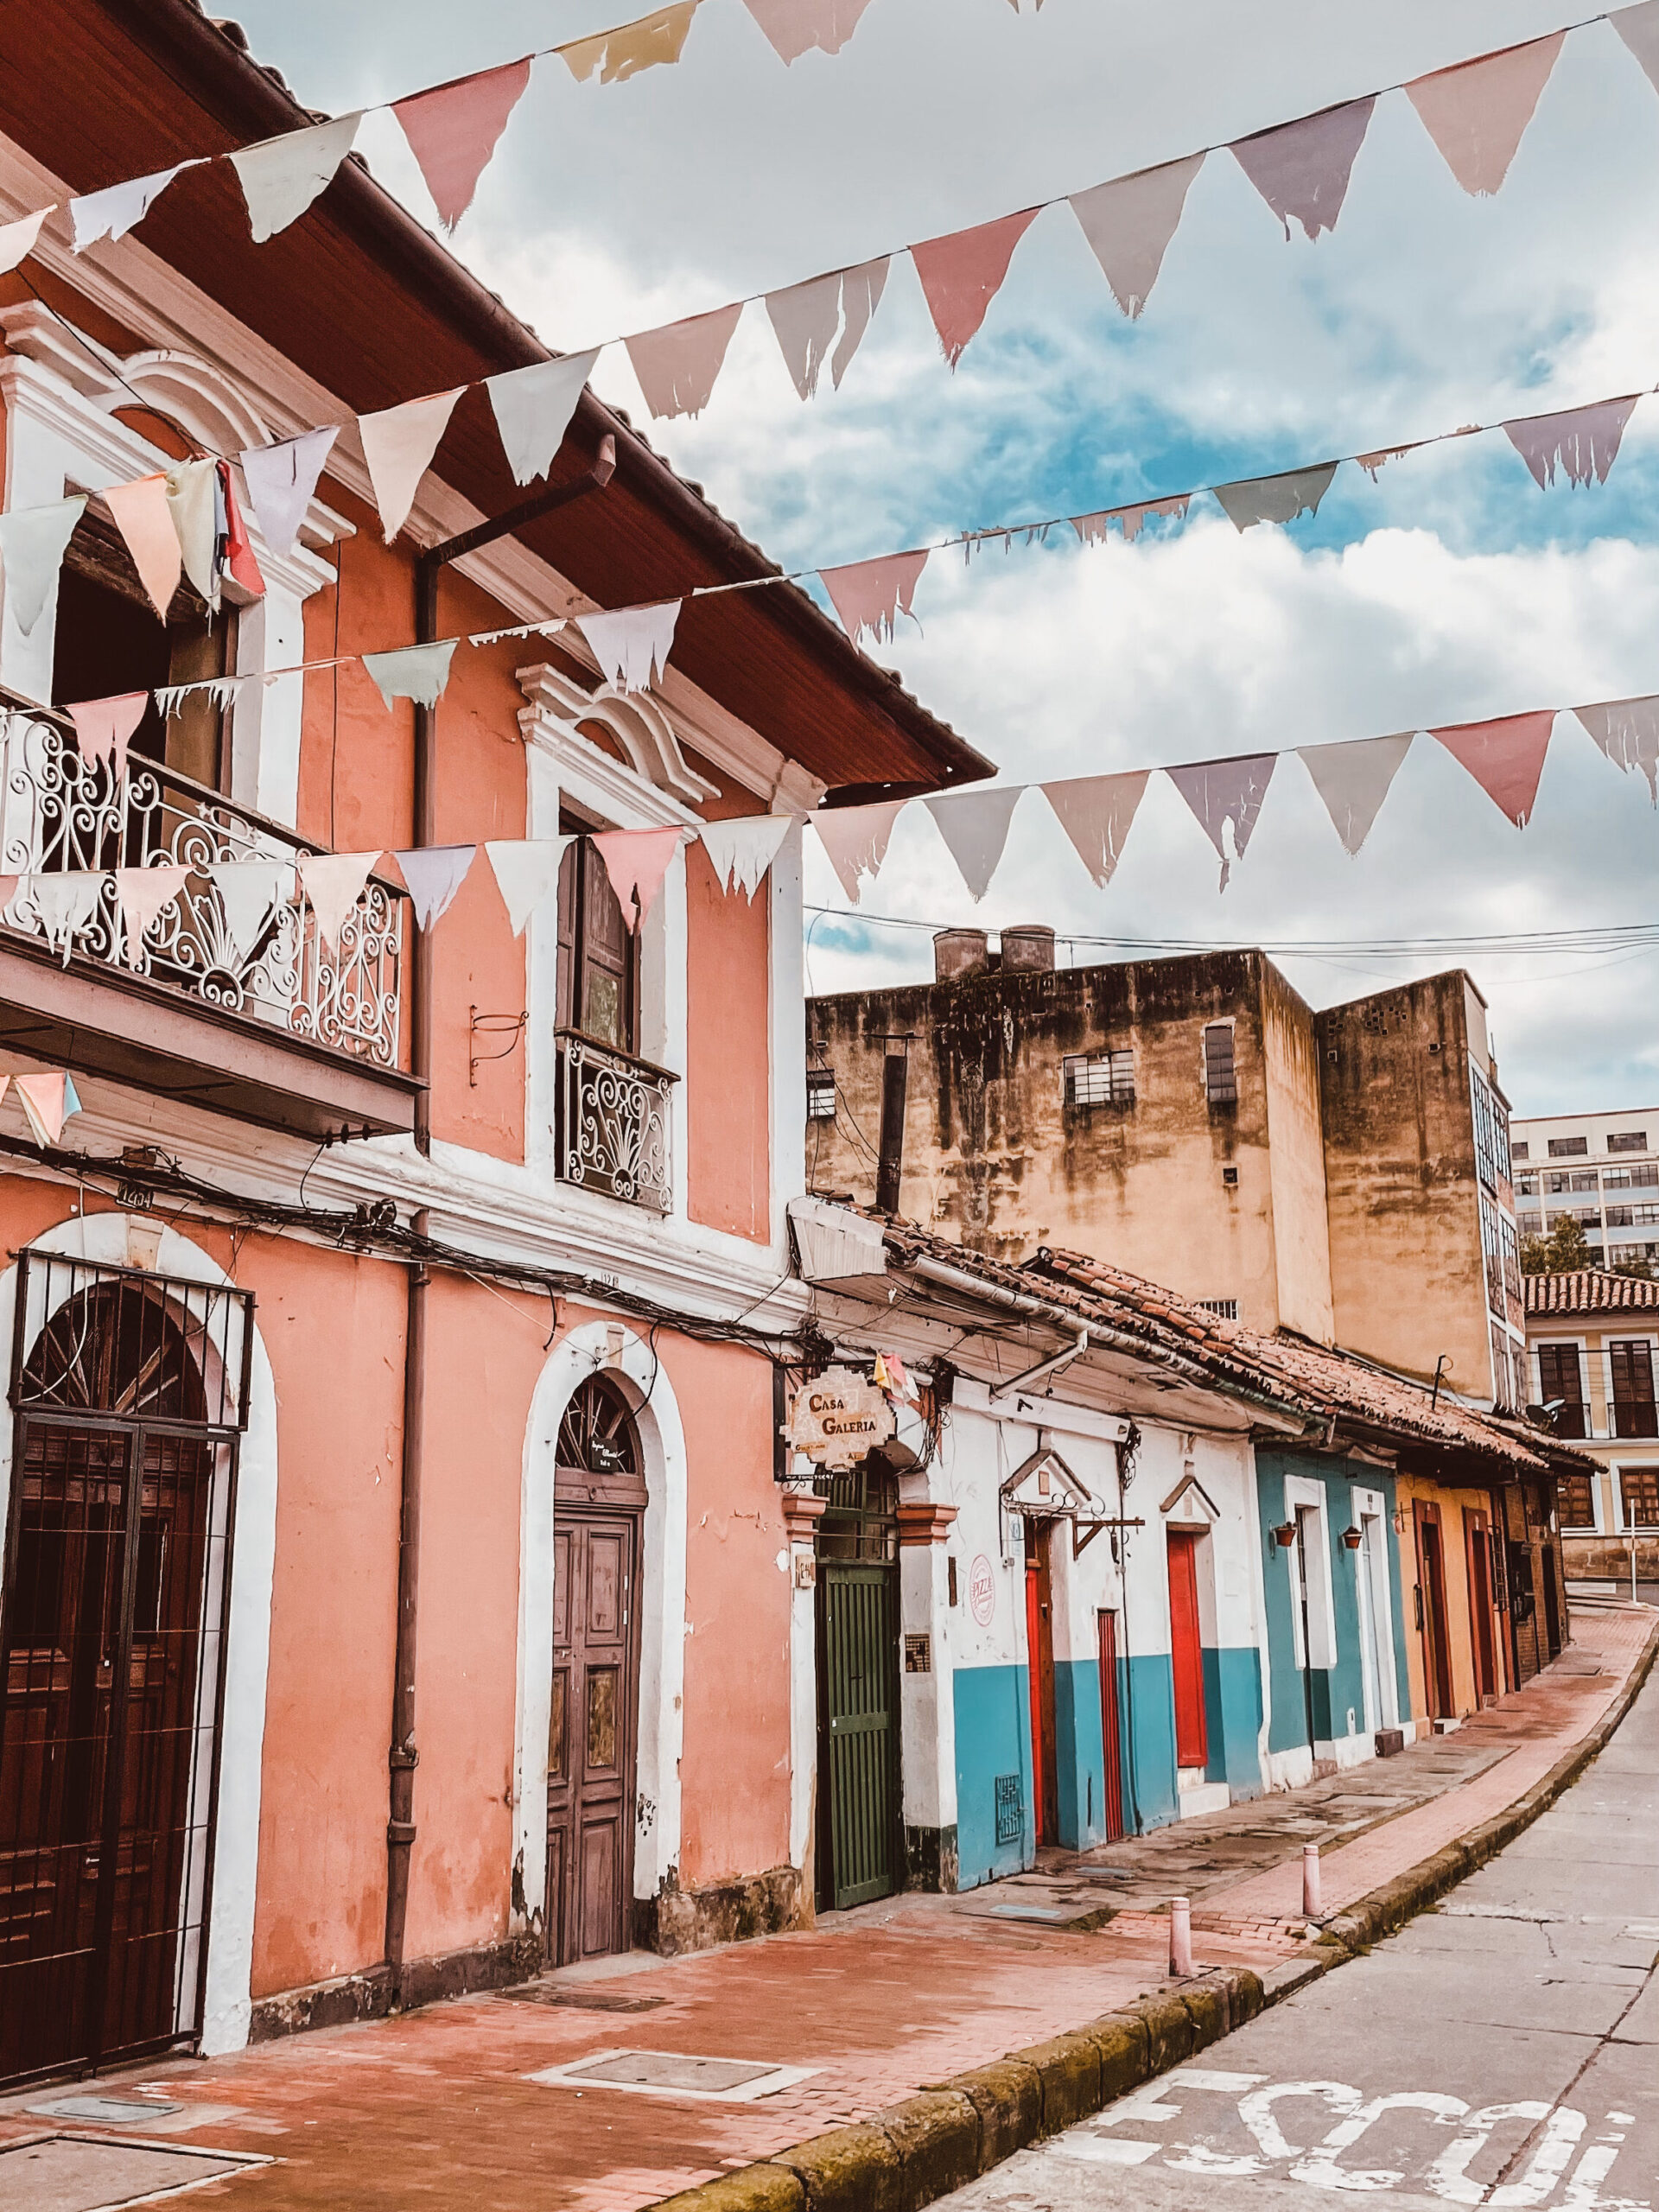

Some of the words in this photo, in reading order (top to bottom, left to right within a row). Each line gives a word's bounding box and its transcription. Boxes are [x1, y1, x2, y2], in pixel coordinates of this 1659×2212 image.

[809, 1394, 844, 1412] CASA
[822, 1417, 876, 1435] GALERIA
[973, 1576, 992, 1598] PIZZA
